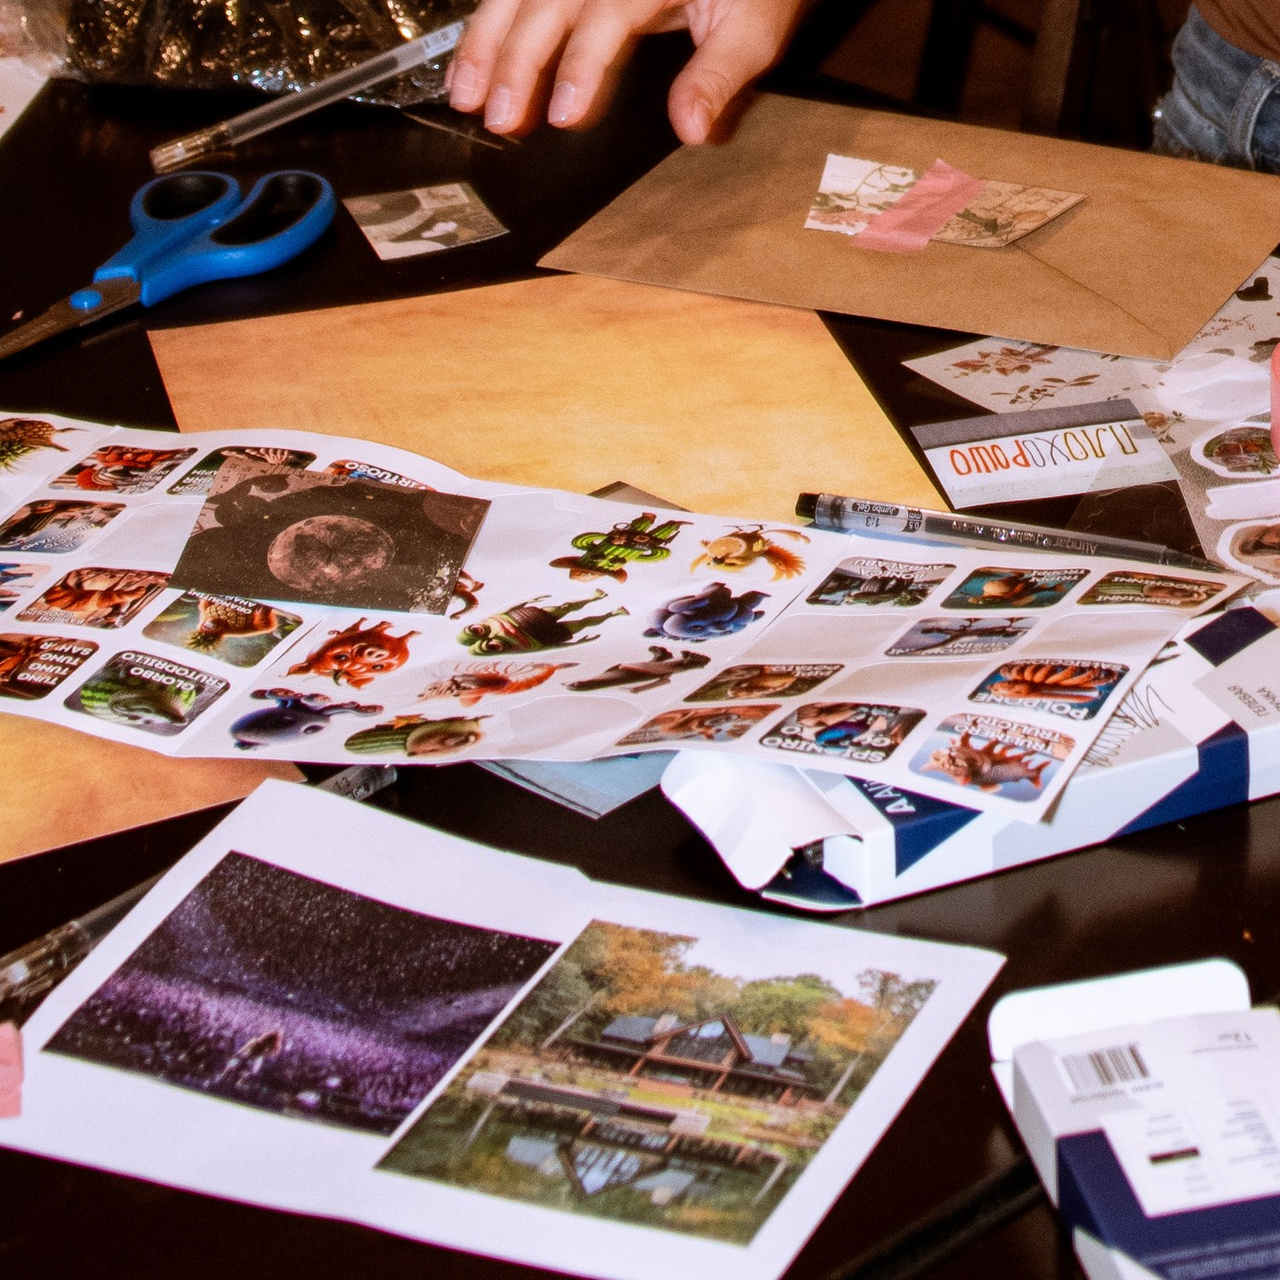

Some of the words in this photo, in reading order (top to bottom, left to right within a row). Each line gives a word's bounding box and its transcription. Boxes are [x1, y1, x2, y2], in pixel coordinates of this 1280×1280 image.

[949, 424, 1139, 476] ПЛОХОРОШО
[344, 462, 426, 490] IRTUOSO
[872, 505, 896, 514] Jumbo
[907, 521, 920, 530] 0.5
[27, 662, 70, 676] TUNG
[38, 652, 81, 666] TUNG
[120, 652, 227, 690] FRUTODRILLO
[16, 672, 59, 686] TUNG
[129, 666, 196, 692] GLORBO
[972, 692, 1089, 721] POLPONE
[1226, 685, 1271, 718] ГЕЛЕВАЯ
